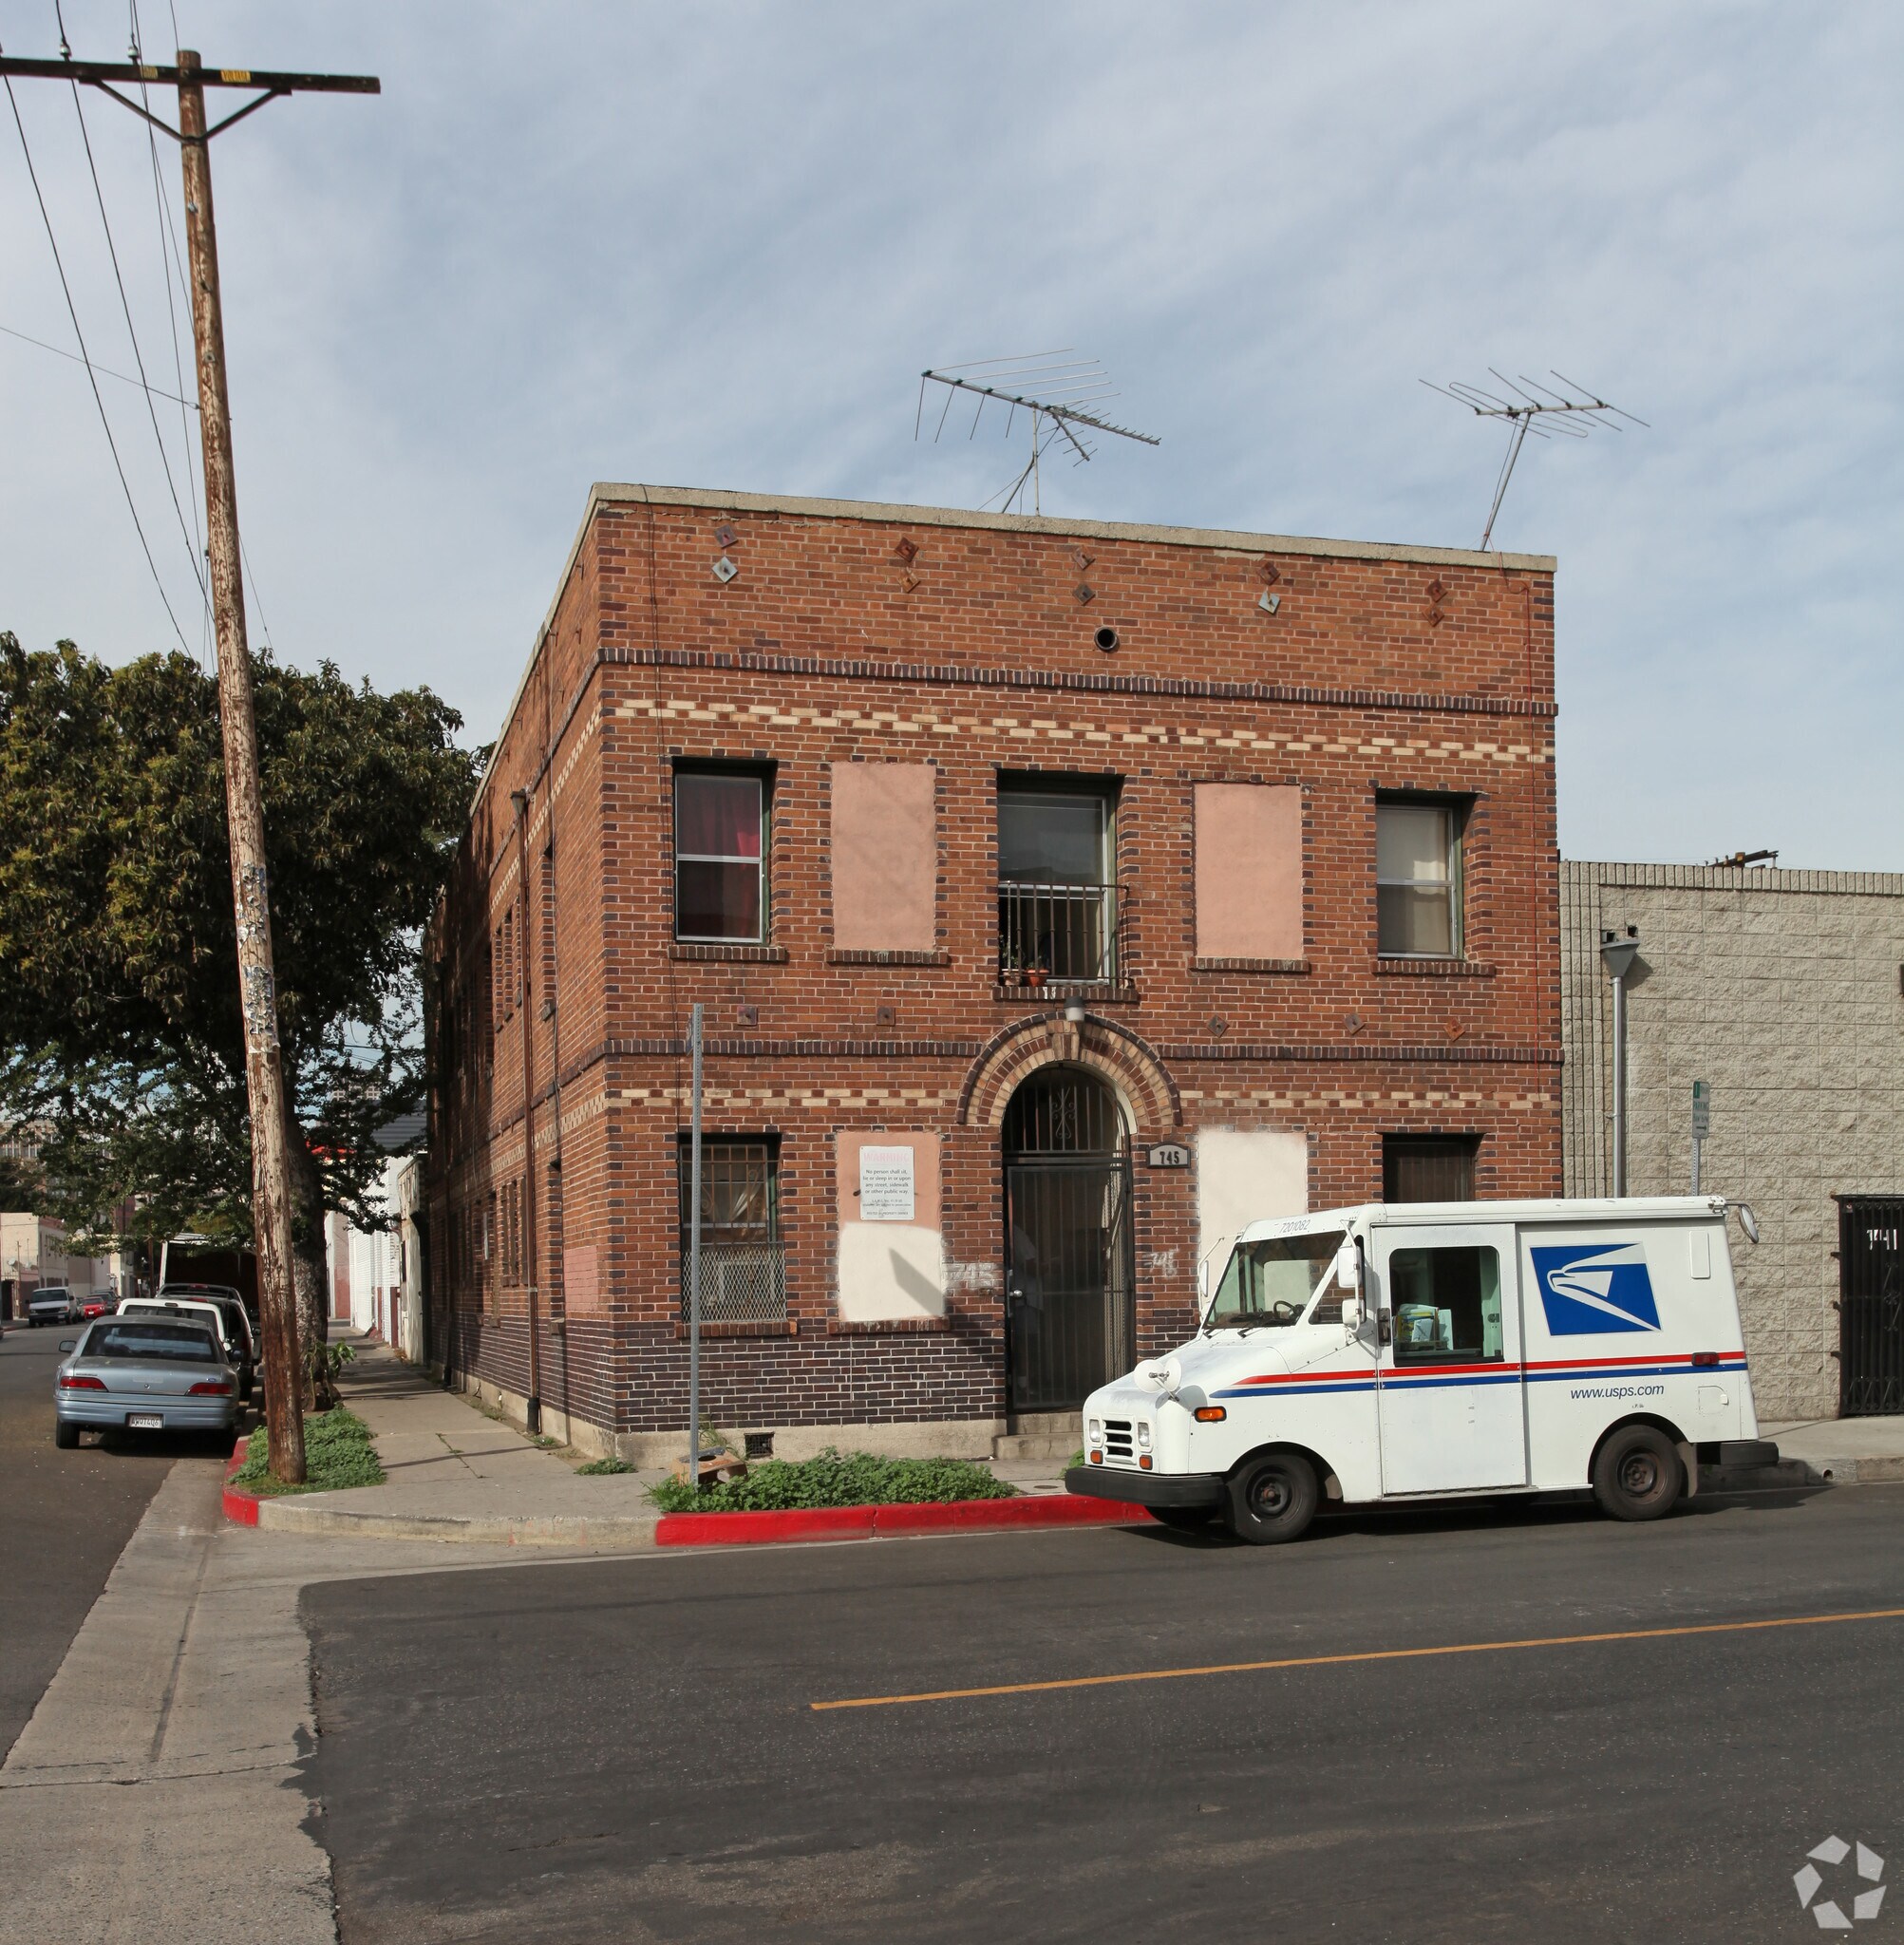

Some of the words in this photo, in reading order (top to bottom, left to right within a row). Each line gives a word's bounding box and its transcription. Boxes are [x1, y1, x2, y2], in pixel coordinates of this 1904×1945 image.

[864, 1152, 909, 1162] WARNING
[1159, 1151, 1179, 1164] 745
[1279, 1219, 1310, 1234] 7201082
[1571, 1385, 1665, 1400] www.usps.com
